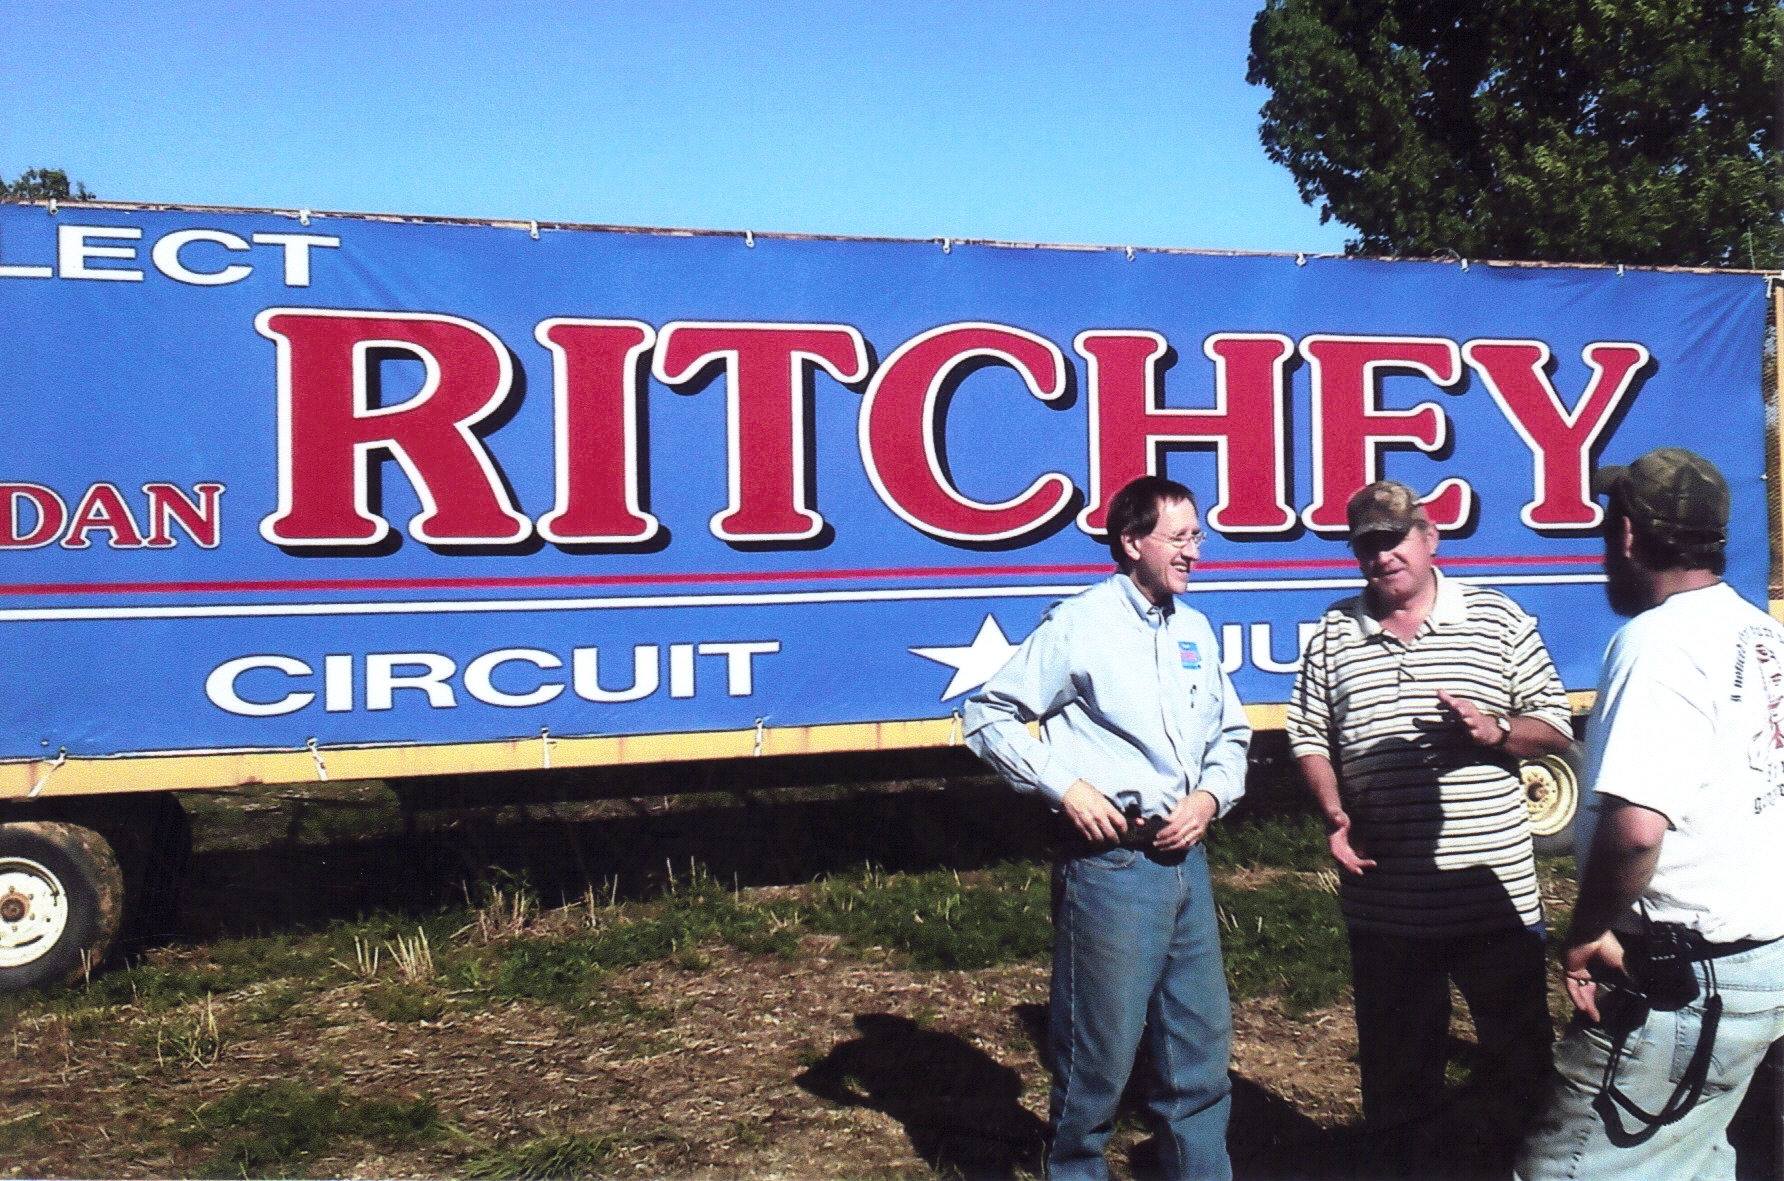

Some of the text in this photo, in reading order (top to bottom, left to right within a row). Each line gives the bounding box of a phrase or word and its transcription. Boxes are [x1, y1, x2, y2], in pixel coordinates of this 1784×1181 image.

[0, 307, 1656, 557] DAN RITCHEY
[204, 641, 781, 717] CIRCUIT
